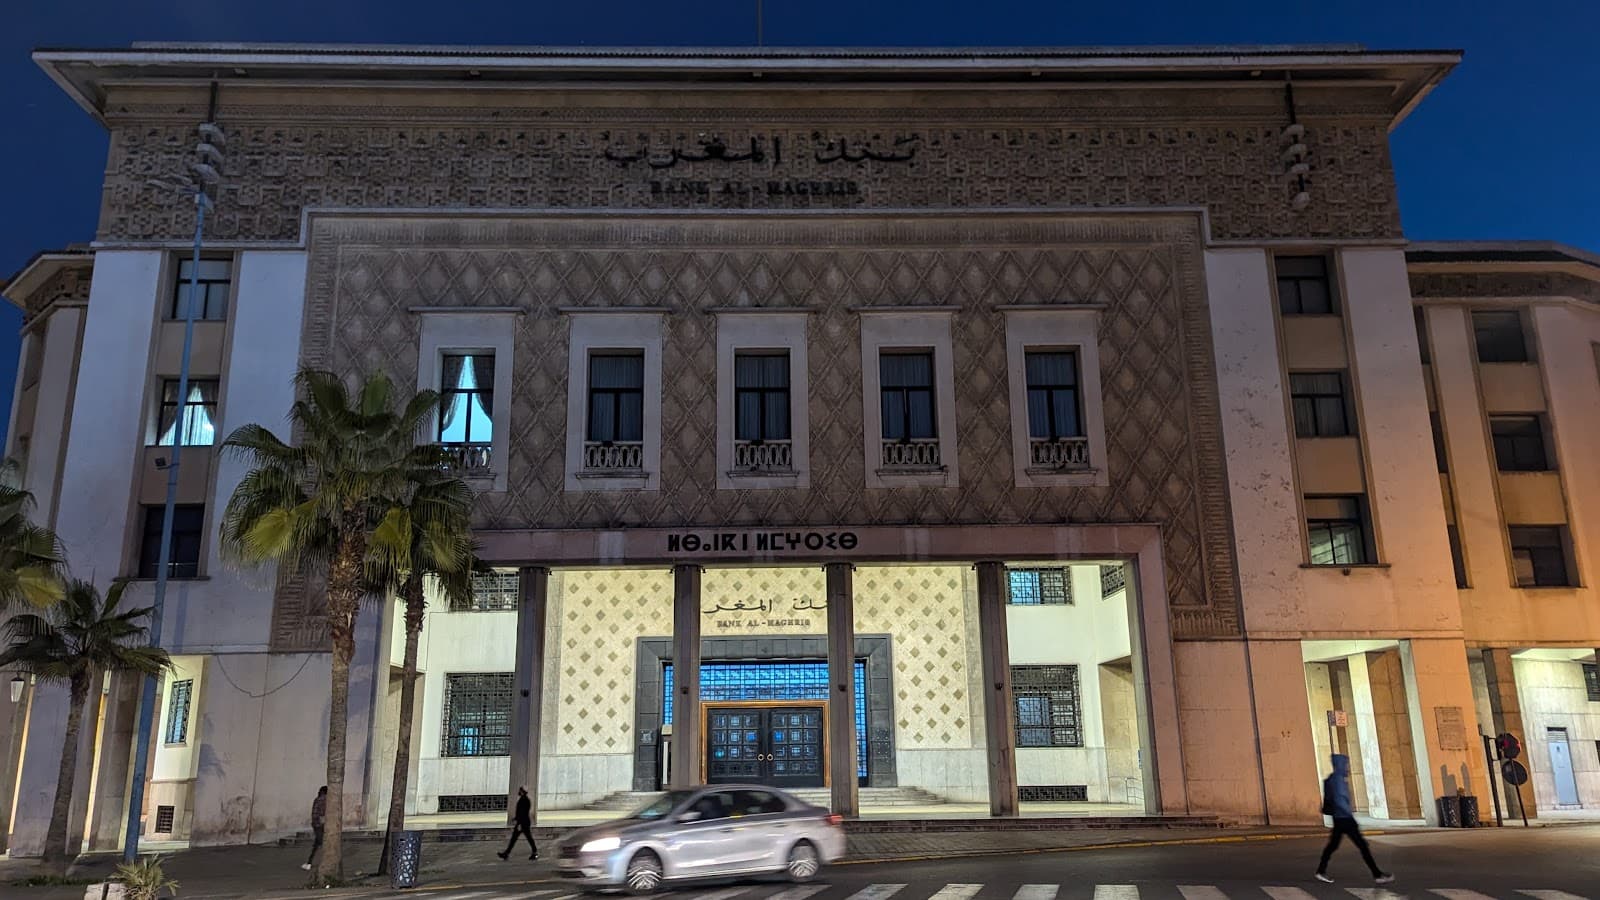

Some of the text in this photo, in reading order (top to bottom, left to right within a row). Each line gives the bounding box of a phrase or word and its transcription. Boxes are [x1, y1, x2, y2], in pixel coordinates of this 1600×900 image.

[603, 131, 920, 169] بنك المغرب
[649, 181, 709, 195] BANK
[703, 599, 772, 613] المغر
[717, 620, 742, 628] BANK
